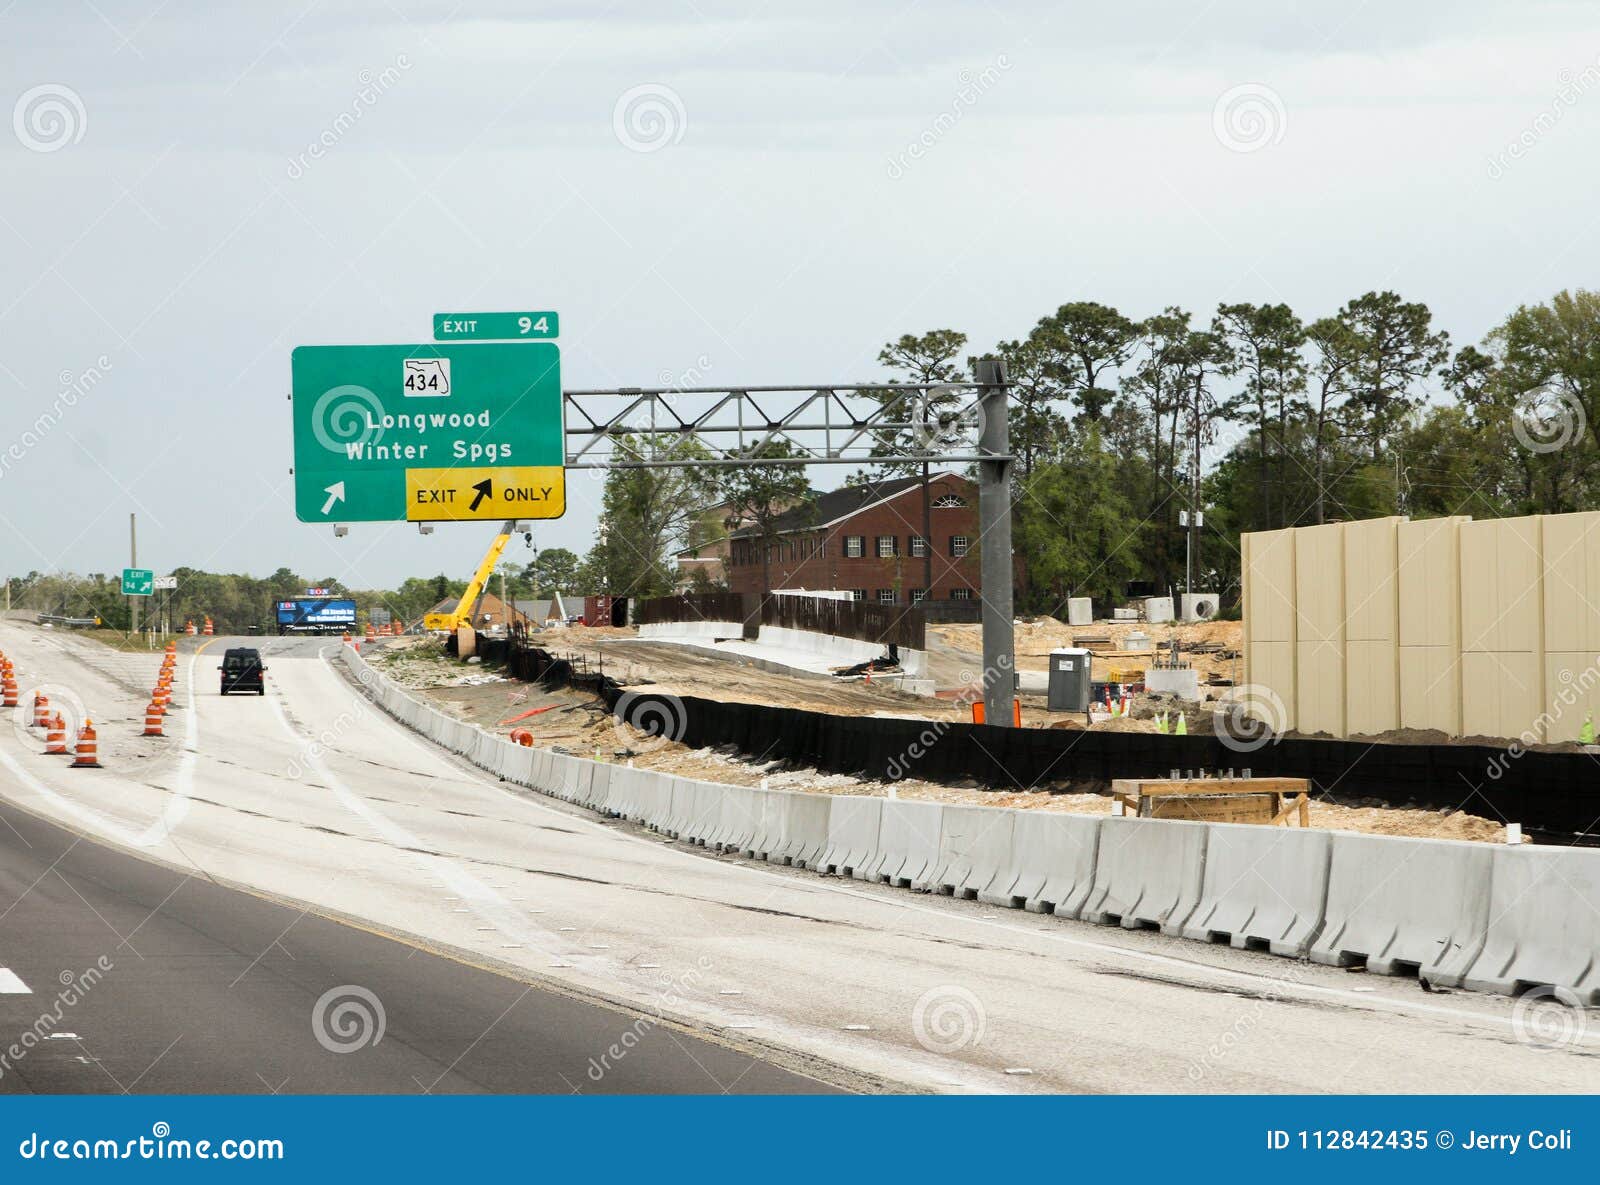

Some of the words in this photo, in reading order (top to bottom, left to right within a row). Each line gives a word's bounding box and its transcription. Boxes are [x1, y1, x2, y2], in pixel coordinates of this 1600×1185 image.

[442, 320, 478, 333] EXIT
[517, 316, 550, 335] 94
[405, 374, 439, 391] 434
[366, 409, 490, 433] Longwood
[345, 442, 429, 460] Winter
[452, 440, 513, 463] Spgs
[416, 489, 457, 504] EXIT
[503, 487, 553, 502] ONLY
